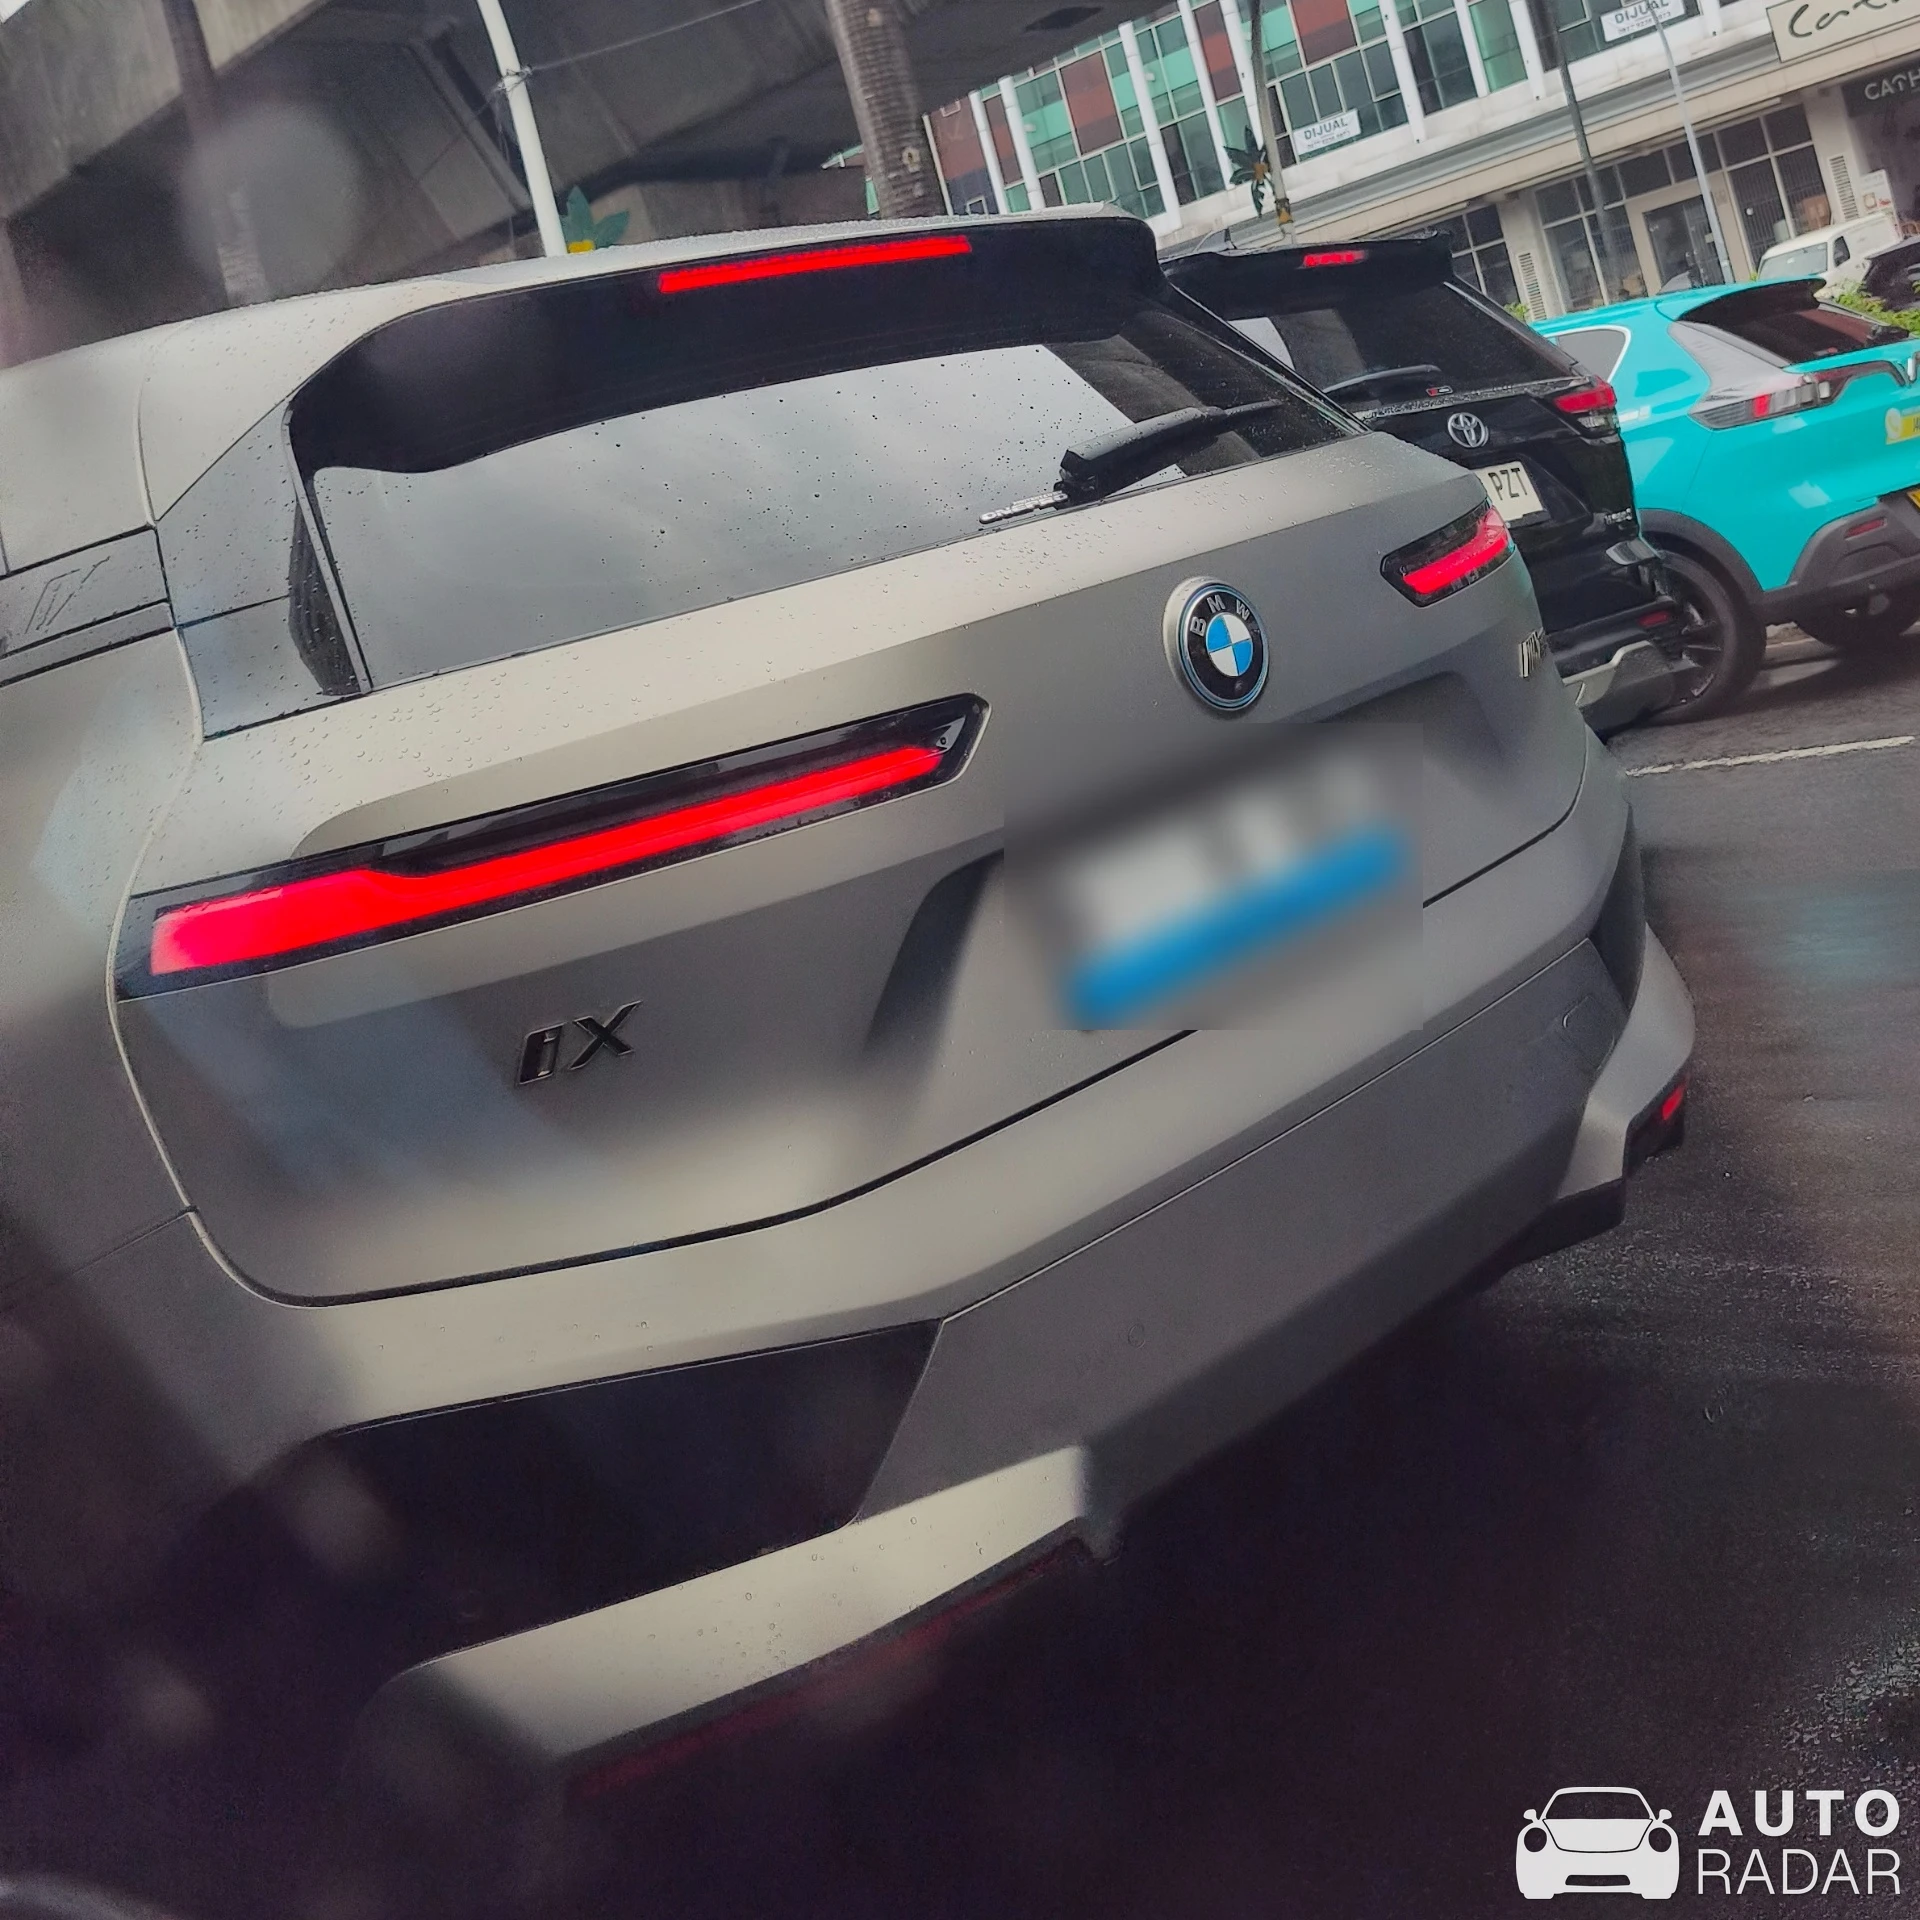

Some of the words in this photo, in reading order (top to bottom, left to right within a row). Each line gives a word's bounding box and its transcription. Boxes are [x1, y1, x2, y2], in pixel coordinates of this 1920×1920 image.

[1614, 0, 1670, 24] DIJUAL
[1304, 118, 1348, 140] DIJUAL
[1488, 467, 1528, 501] PZT
[1190, 594, 1250, 637] BMW
[519, 1000, 643, 1085] iX
